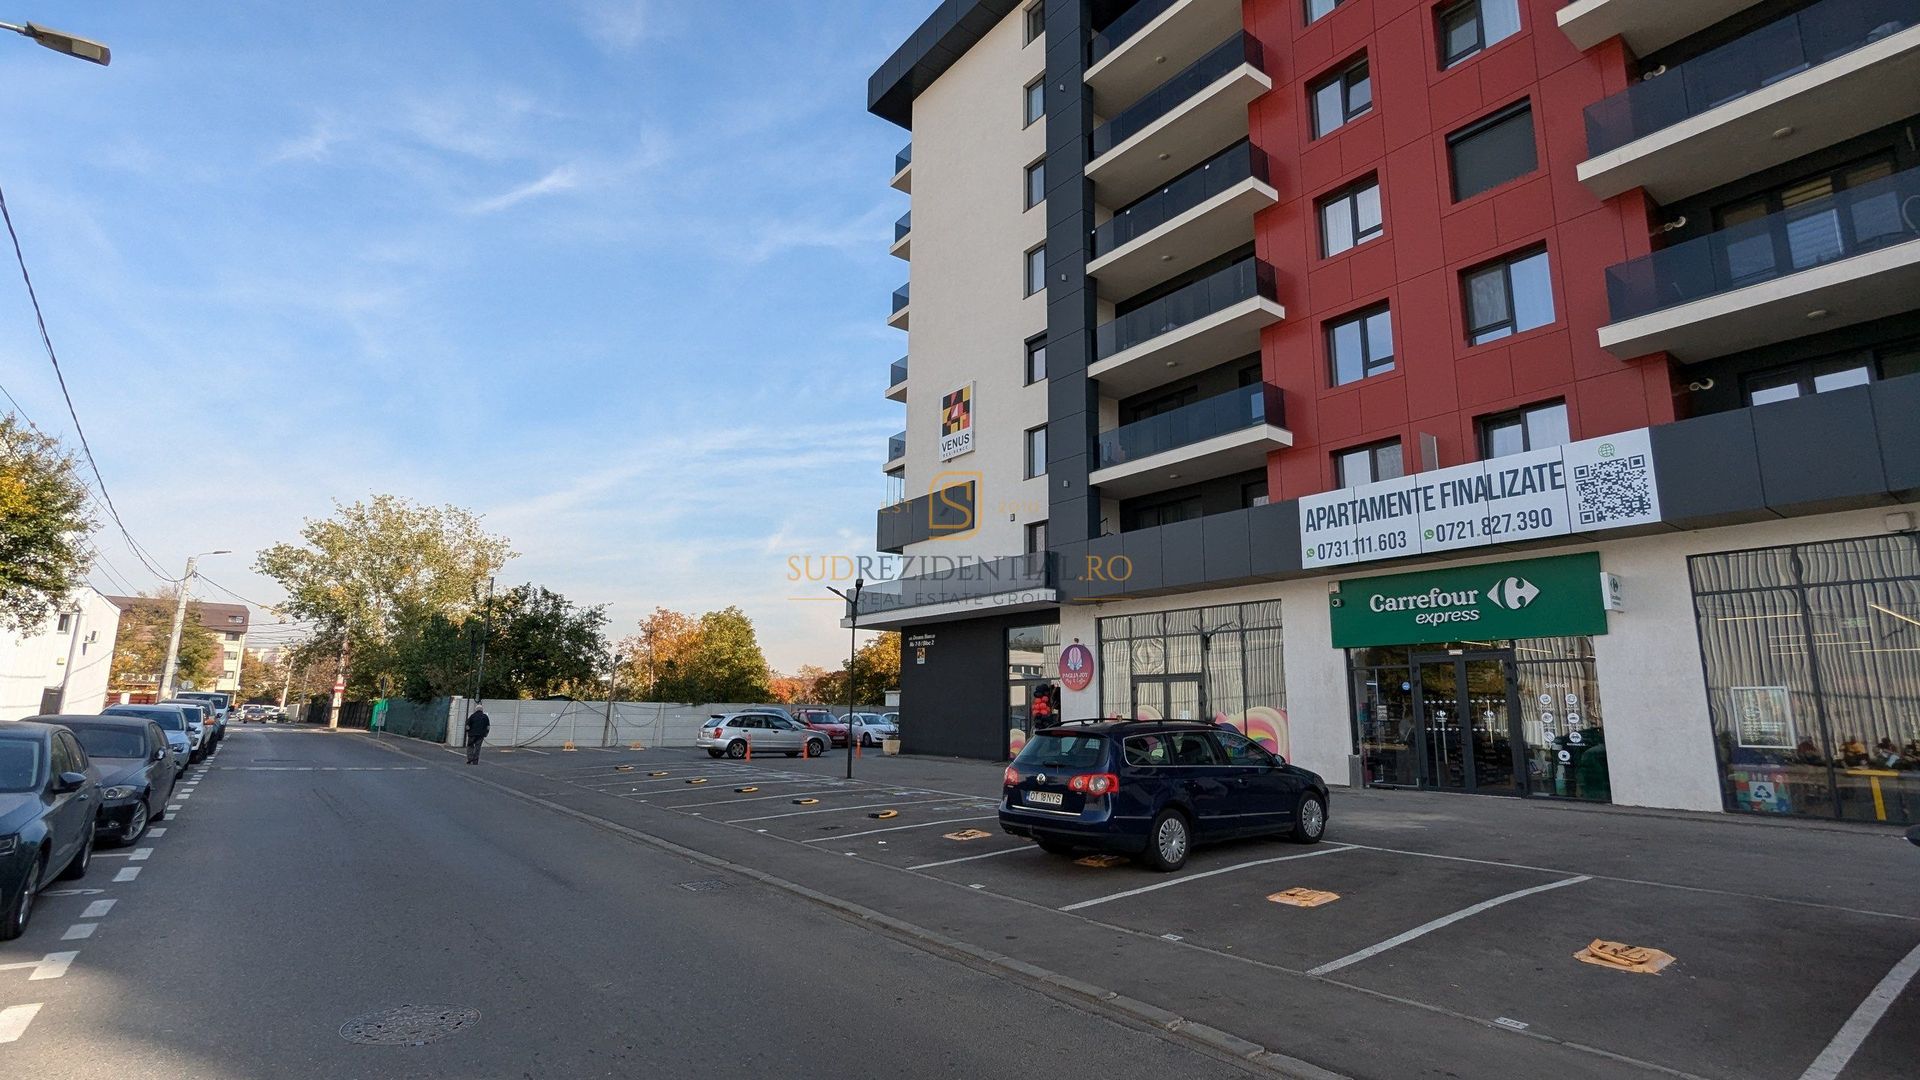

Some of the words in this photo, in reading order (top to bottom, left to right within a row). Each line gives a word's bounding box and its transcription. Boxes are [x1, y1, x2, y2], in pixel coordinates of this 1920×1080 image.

[941, 433, 970, 452] VENUS
[1305, 484, 1436, 533] APARTAMENTE
[1440, 460, 1565, 509] FINALIZATE
[1435, 507, 1553, 543] 0721.827.390
[1317, 530, 1407, 560] 0731.111.603
[1369, 587, 1480, 613] Carrefour
[1415, 607, 1480, 626] express
[1030, 791, 1039, 801] OT
[1047, 793, 1062, 804] NYS
